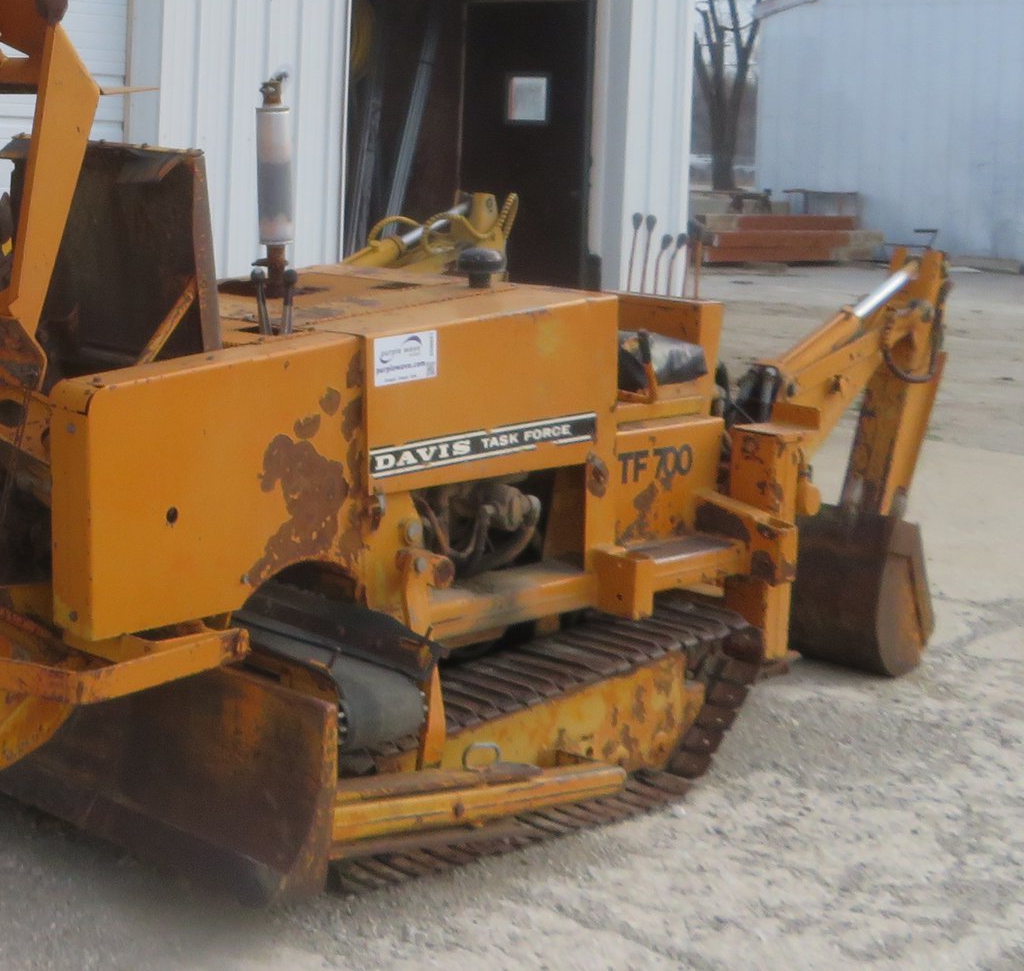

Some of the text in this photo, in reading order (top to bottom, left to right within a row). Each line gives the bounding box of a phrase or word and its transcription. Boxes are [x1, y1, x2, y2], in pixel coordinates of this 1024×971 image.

[374, 424, 572, 471] DAVIS TASK FORCE
[618, 443, 693, 485] TF 700
